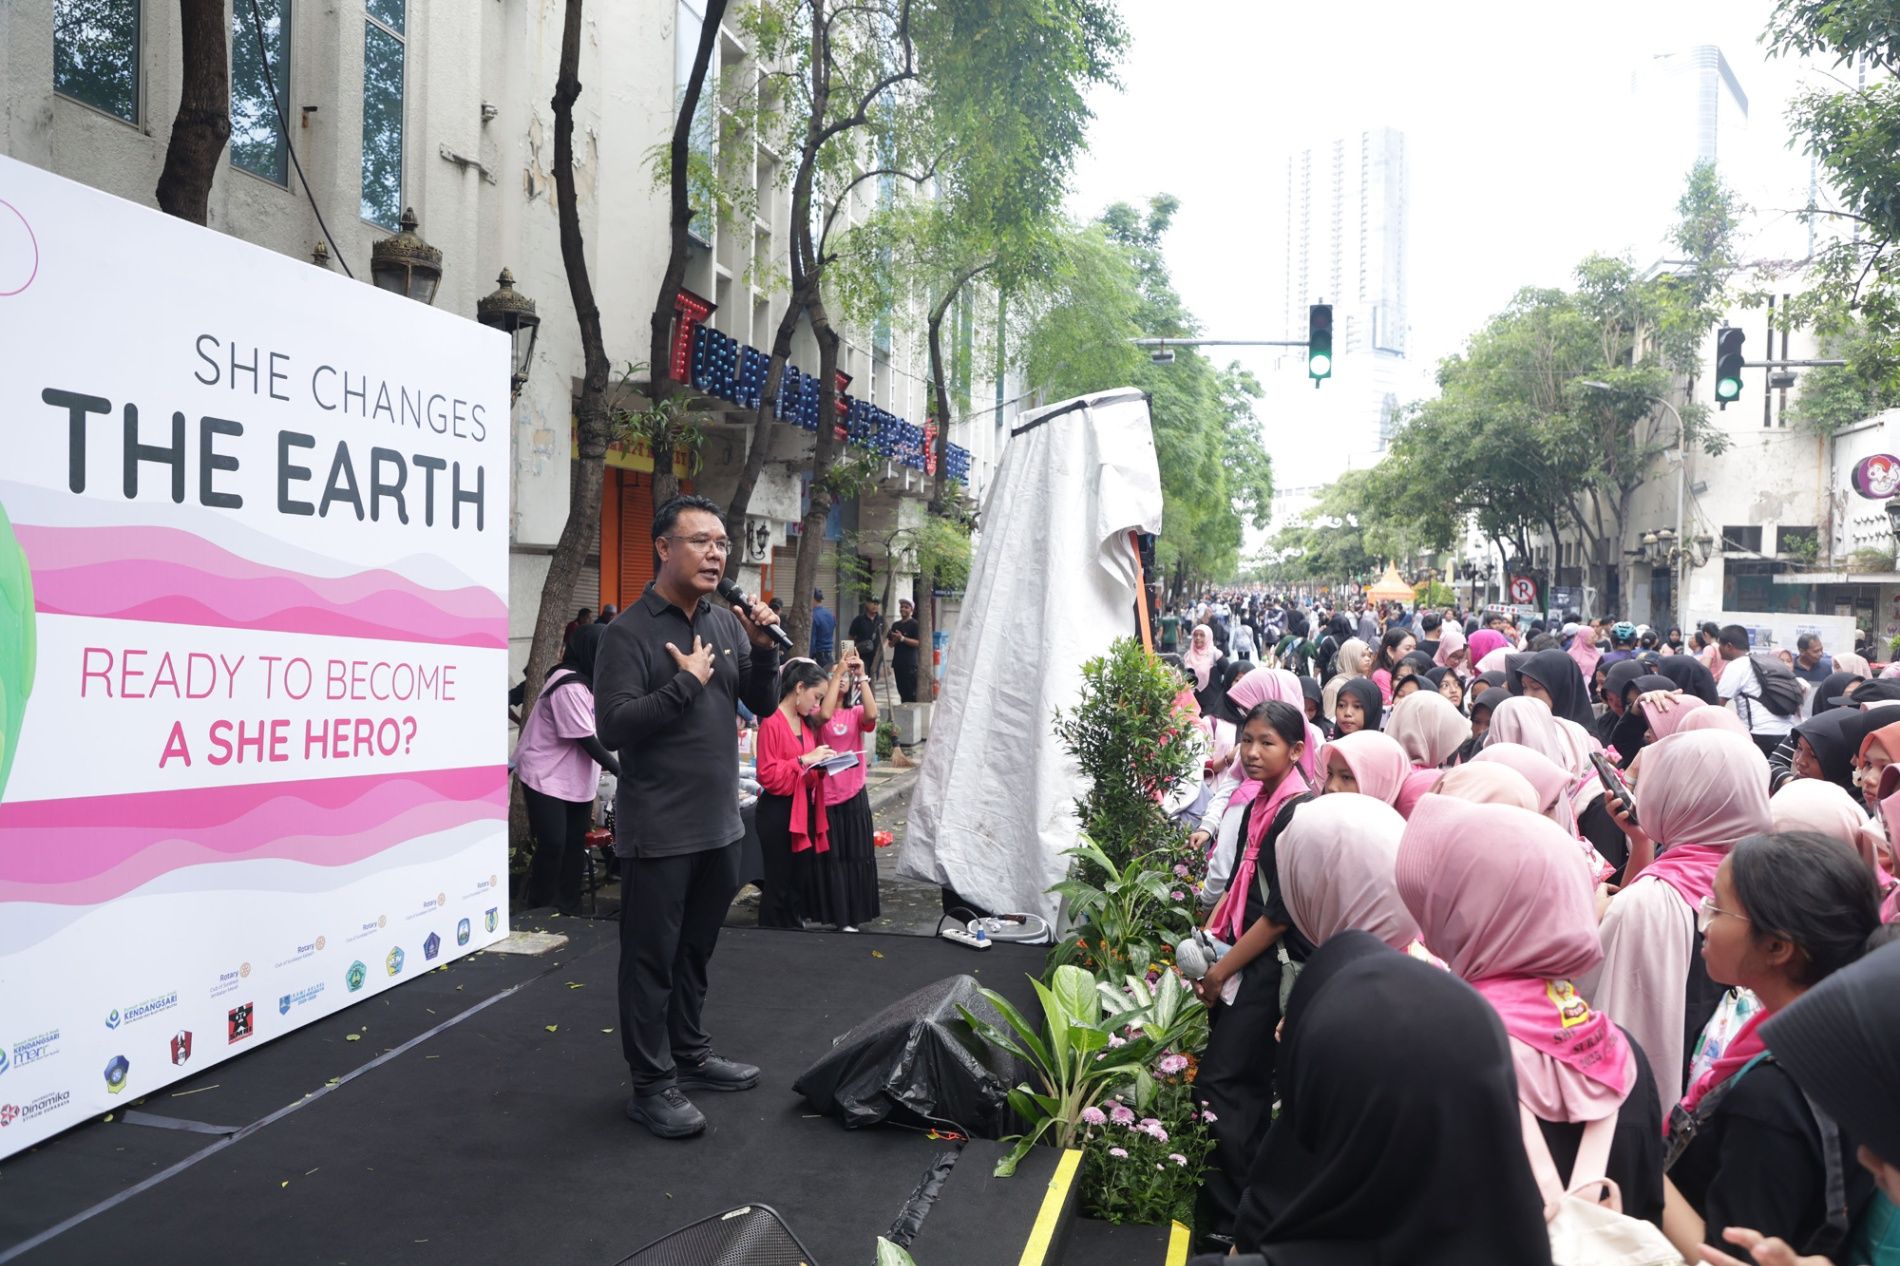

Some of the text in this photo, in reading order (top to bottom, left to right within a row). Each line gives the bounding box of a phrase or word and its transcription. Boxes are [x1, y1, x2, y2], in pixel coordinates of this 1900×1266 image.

[195, 334, 486, 442] SHE CHANGES
[41, 387, 485, 532] THE EARTH
[81, 647, 457, 701] READY TO BECOME
[159, 715, 418, 768] A SHE HERO?
[297, 943, 315, 954] Rotary
[220, 970, 239, 982] Rotary
[124, 994, 178, 1020] KENDANGSARI
[13, 1033, 60, 1054] KENDANGSARI
[22, 1090, 70, 1117] Dinamika
